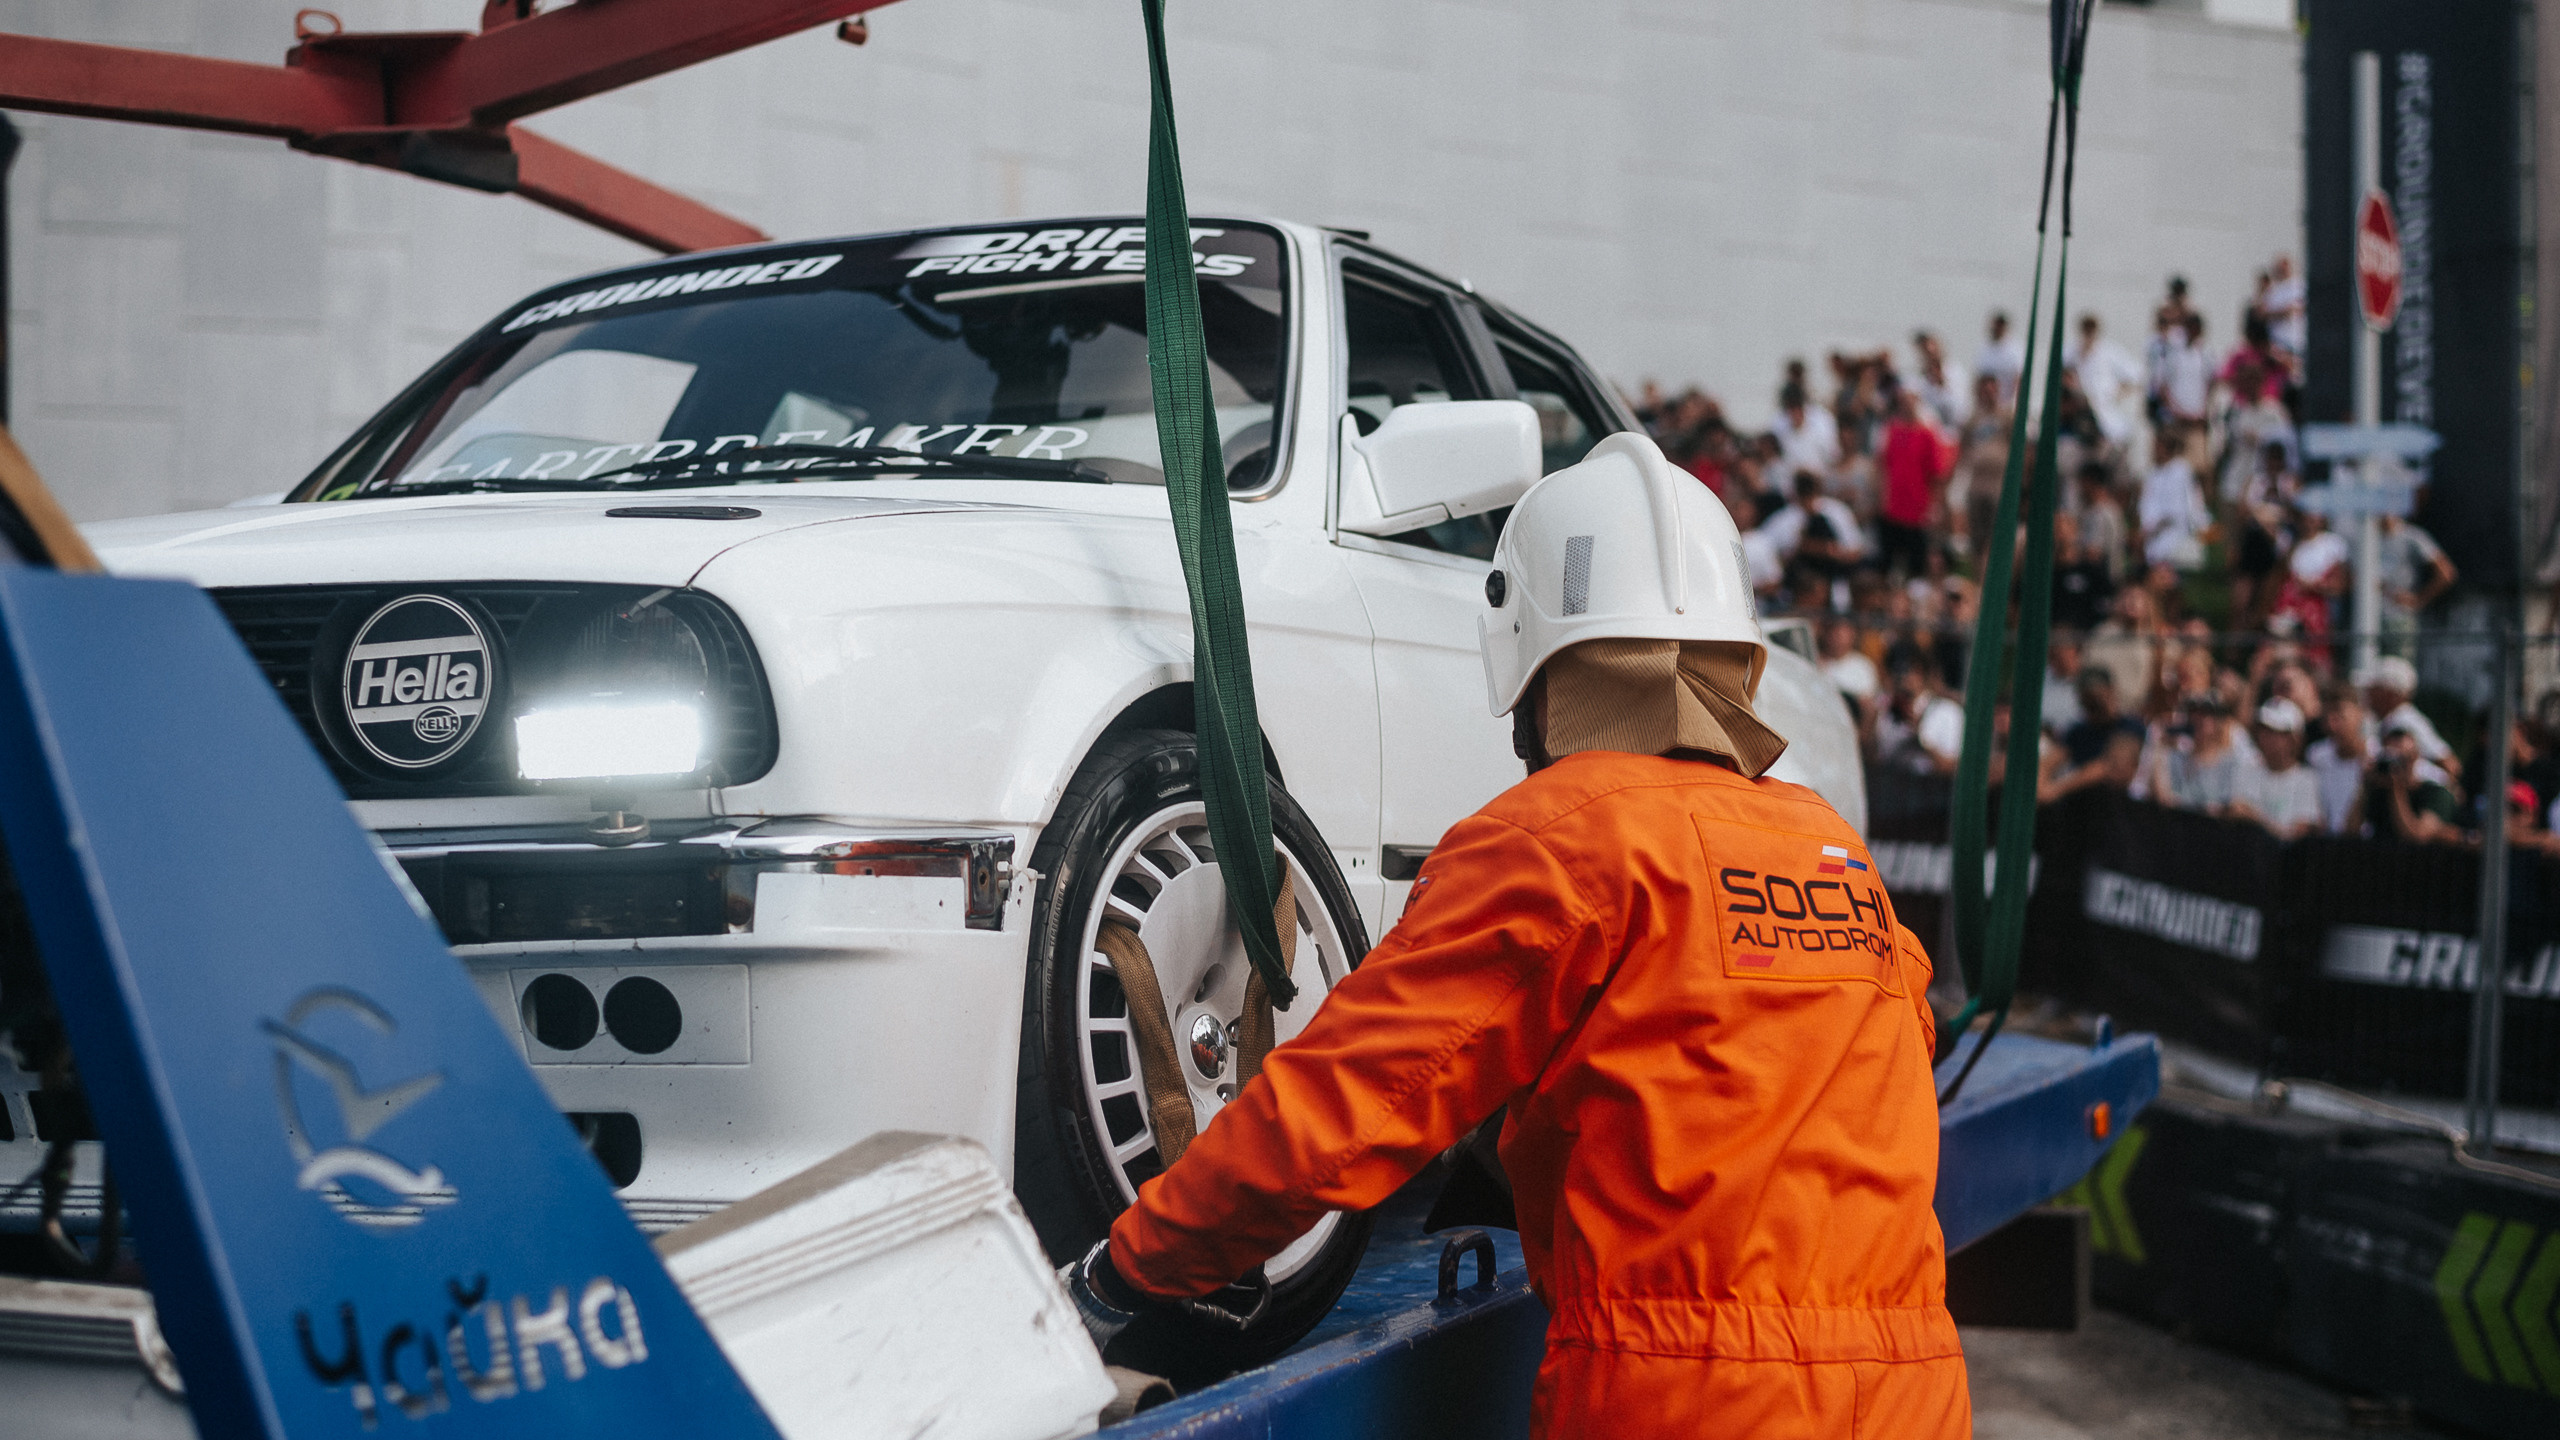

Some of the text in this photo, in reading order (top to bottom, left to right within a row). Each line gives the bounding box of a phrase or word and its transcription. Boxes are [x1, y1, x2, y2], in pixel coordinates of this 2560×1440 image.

[501, 254, 844, 335] GROUNDED
[357, 654, 478, 706] Hella
[418, 714, 460, 732] HELLA
[1719, 867, 1889, 933] SOCHI
[1730, 920, 1895, 967] AUTODROM
[296, 1273, 649, 1431] Чайка
